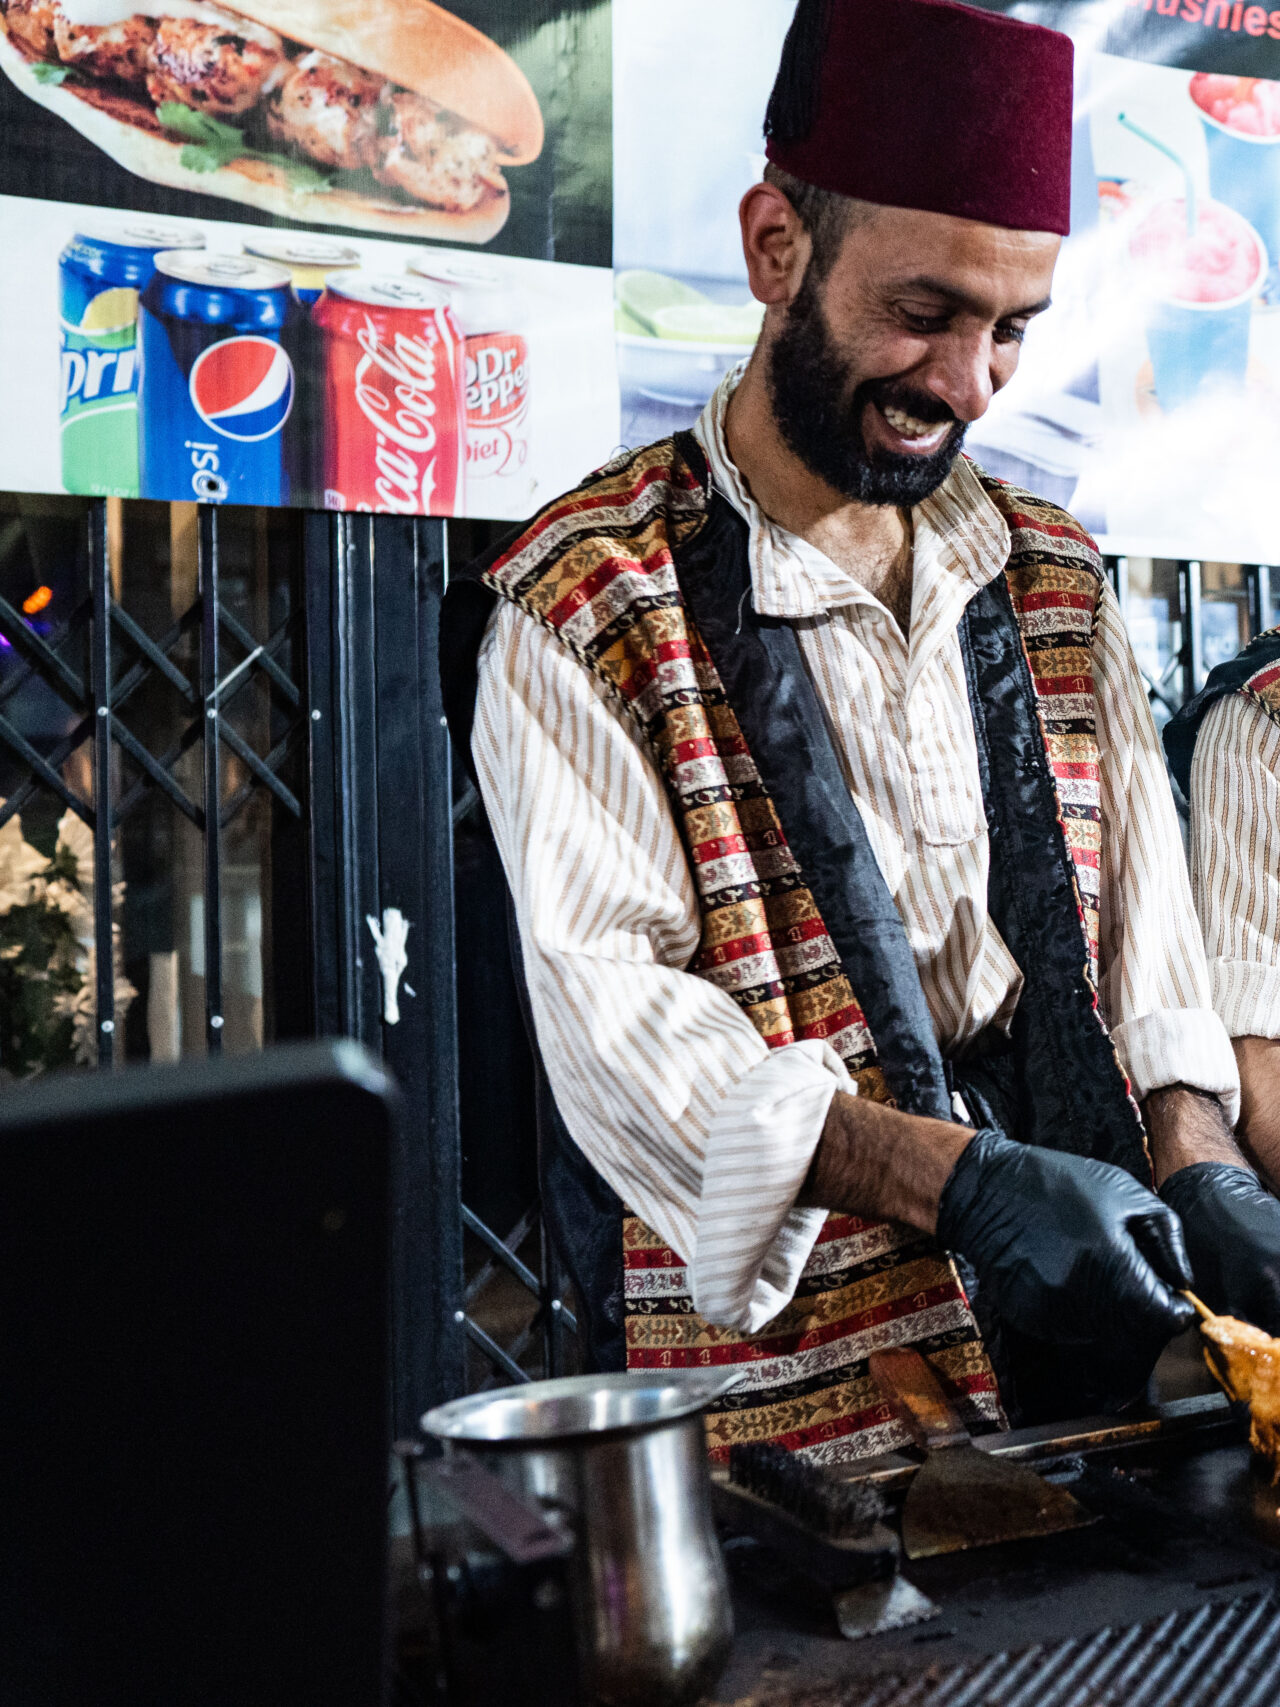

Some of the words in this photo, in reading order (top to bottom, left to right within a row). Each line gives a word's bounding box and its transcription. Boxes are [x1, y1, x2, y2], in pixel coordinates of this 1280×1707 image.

[58, 346, 138, 415] pri
[466, 356, 528, 416] eppe
[477, 347, 517, 385] Dr
[355, 312, 437, 513] ca-Cola
[185, 440, 229, 504] psi
